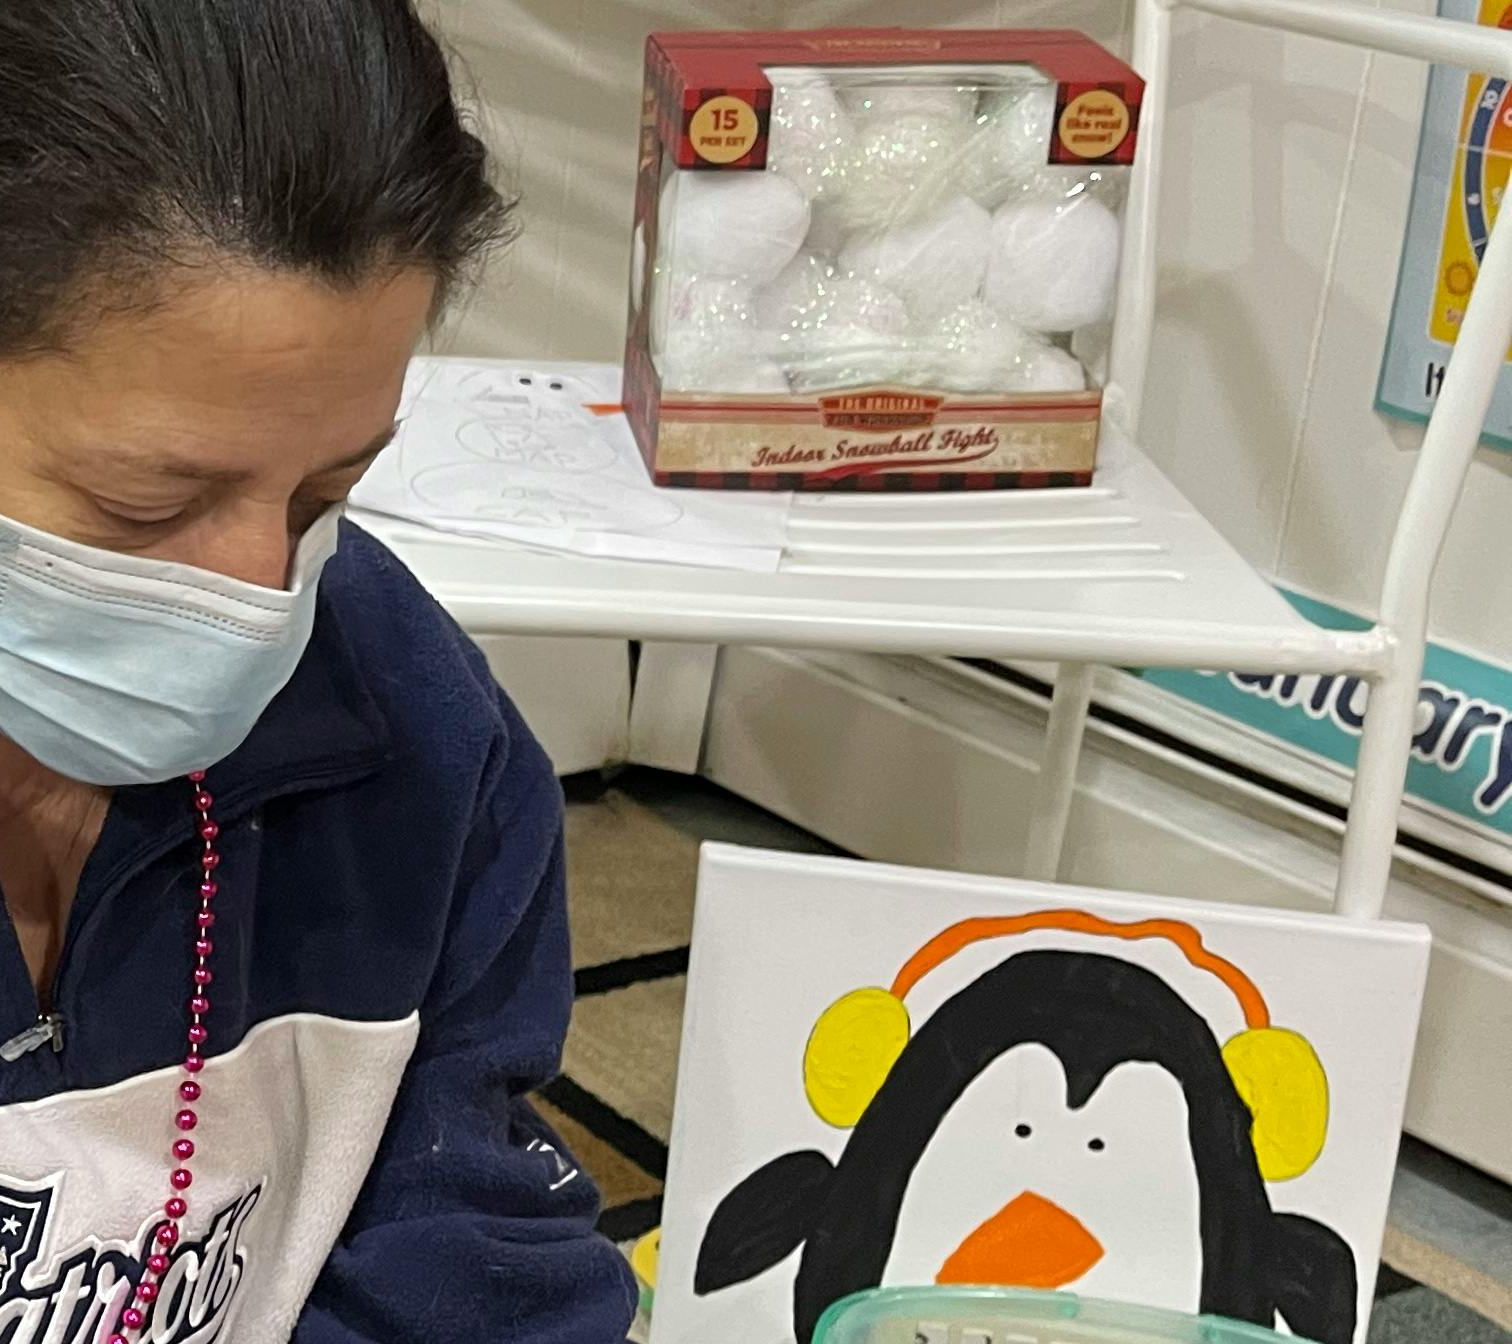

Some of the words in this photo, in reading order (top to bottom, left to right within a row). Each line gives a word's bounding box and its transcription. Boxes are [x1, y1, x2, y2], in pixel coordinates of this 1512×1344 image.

[712, 109, 739, 131] 15
[751, 444, 826, 467] Indoor
[831, 430, 935, 461] Snowball
[937, 425, 998, 453] Fight
